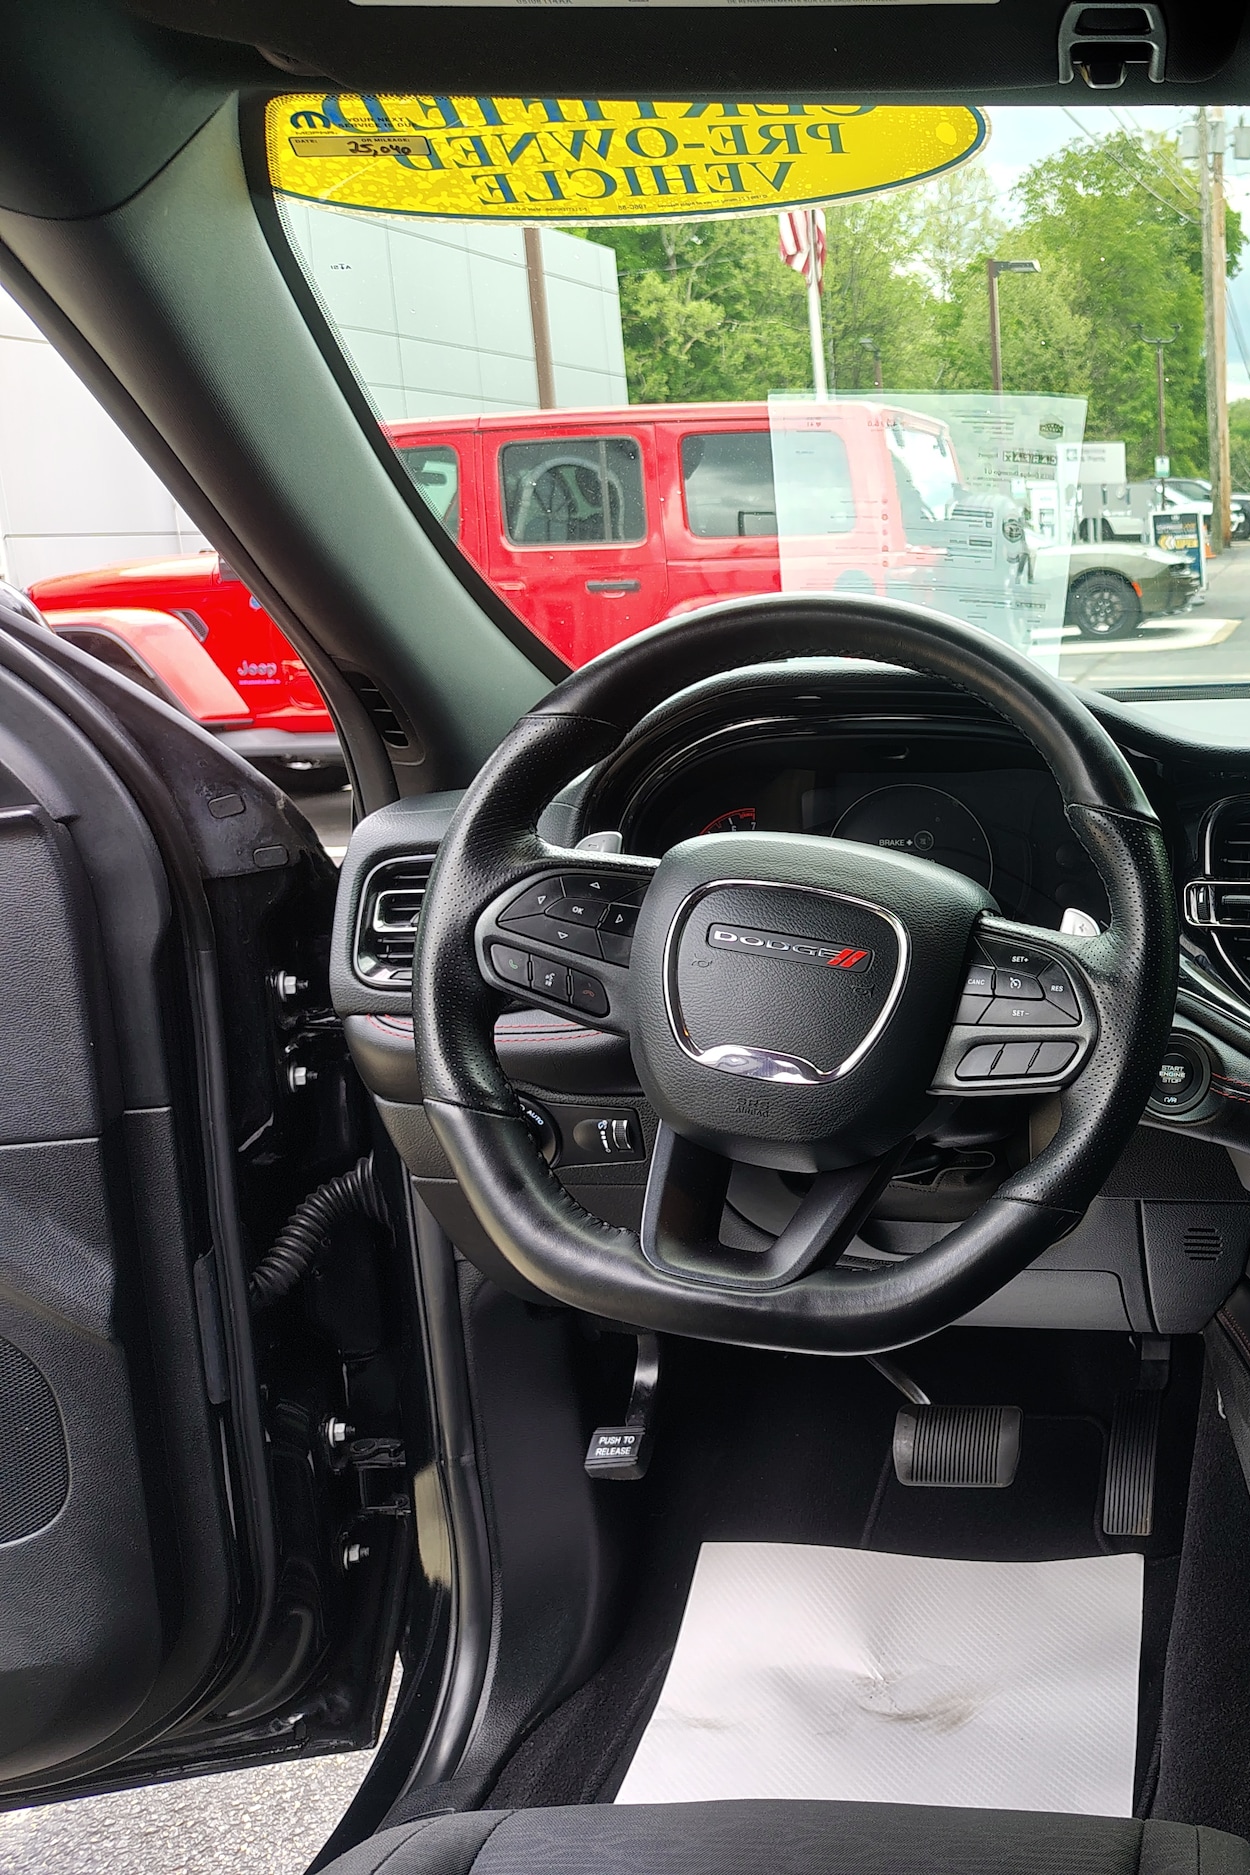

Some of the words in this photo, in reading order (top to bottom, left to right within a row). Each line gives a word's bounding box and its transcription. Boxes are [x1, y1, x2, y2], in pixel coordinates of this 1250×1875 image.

[750, 822, 757, 830] 7
[878, 838, 905, 847] BRAKE
[571, 905, 585, 915] OK
[713, 930, 839, 959] DODGE
[1158, 1071, 1186, 1079] ENGINE
[526, 1109, 545, 1126] AUTO
[598, 1436, 621, 1445] PUSH
[623, 1435, 636, 1444] TO
[595, 1446, 632, 1456] RELEASE
